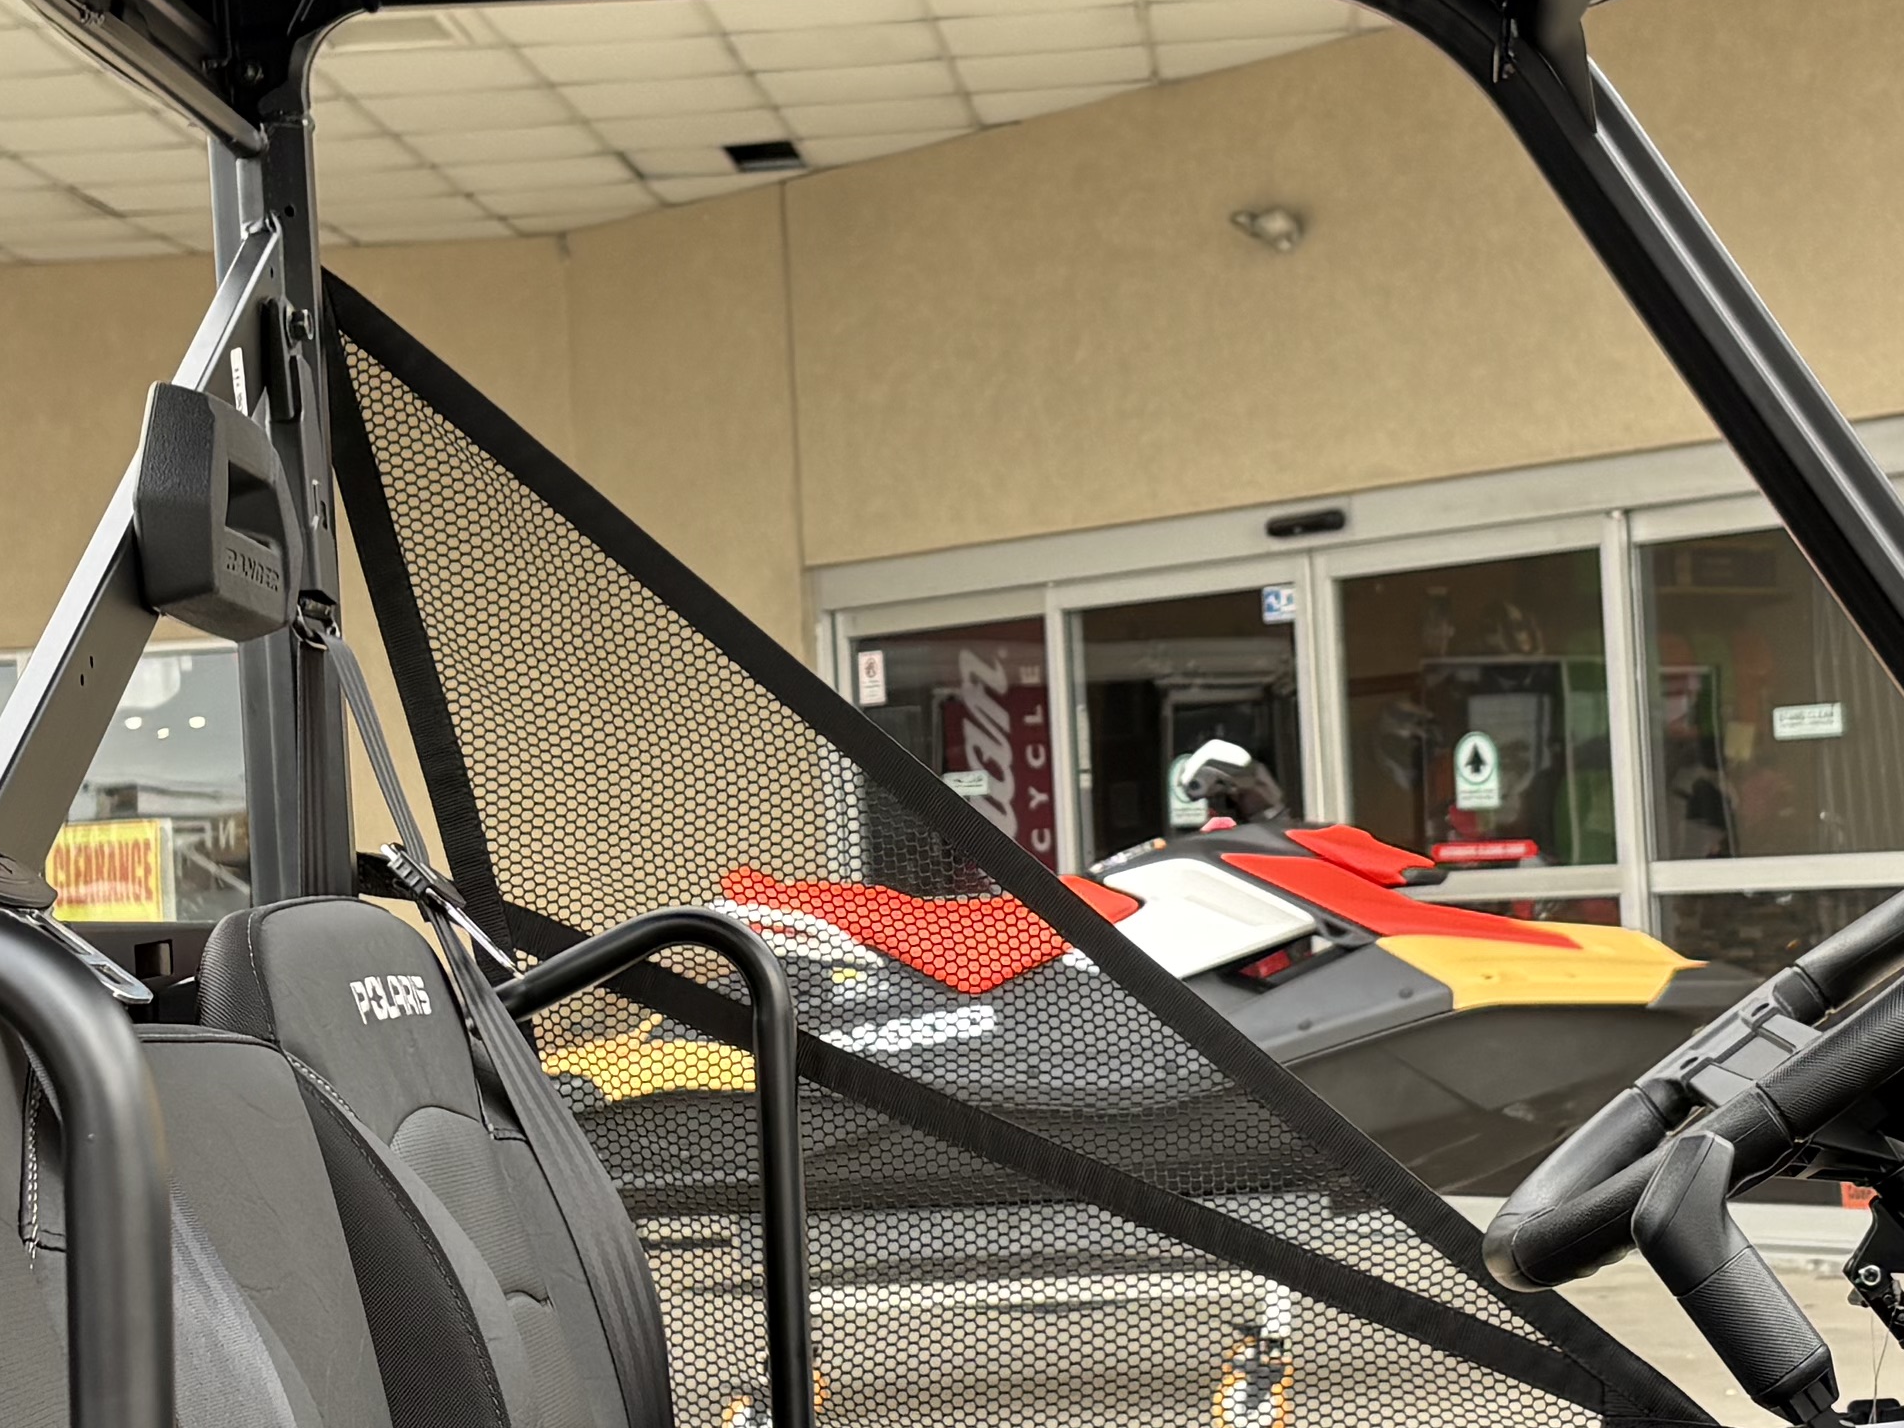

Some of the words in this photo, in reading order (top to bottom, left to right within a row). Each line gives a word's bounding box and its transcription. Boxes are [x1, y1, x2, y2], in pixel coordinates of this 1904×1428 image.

[225, 547, 280, 593] RANGER
[52, 836, 155, 906] CLEARANCE
[349, 975, 432, 1025] POLARIS
